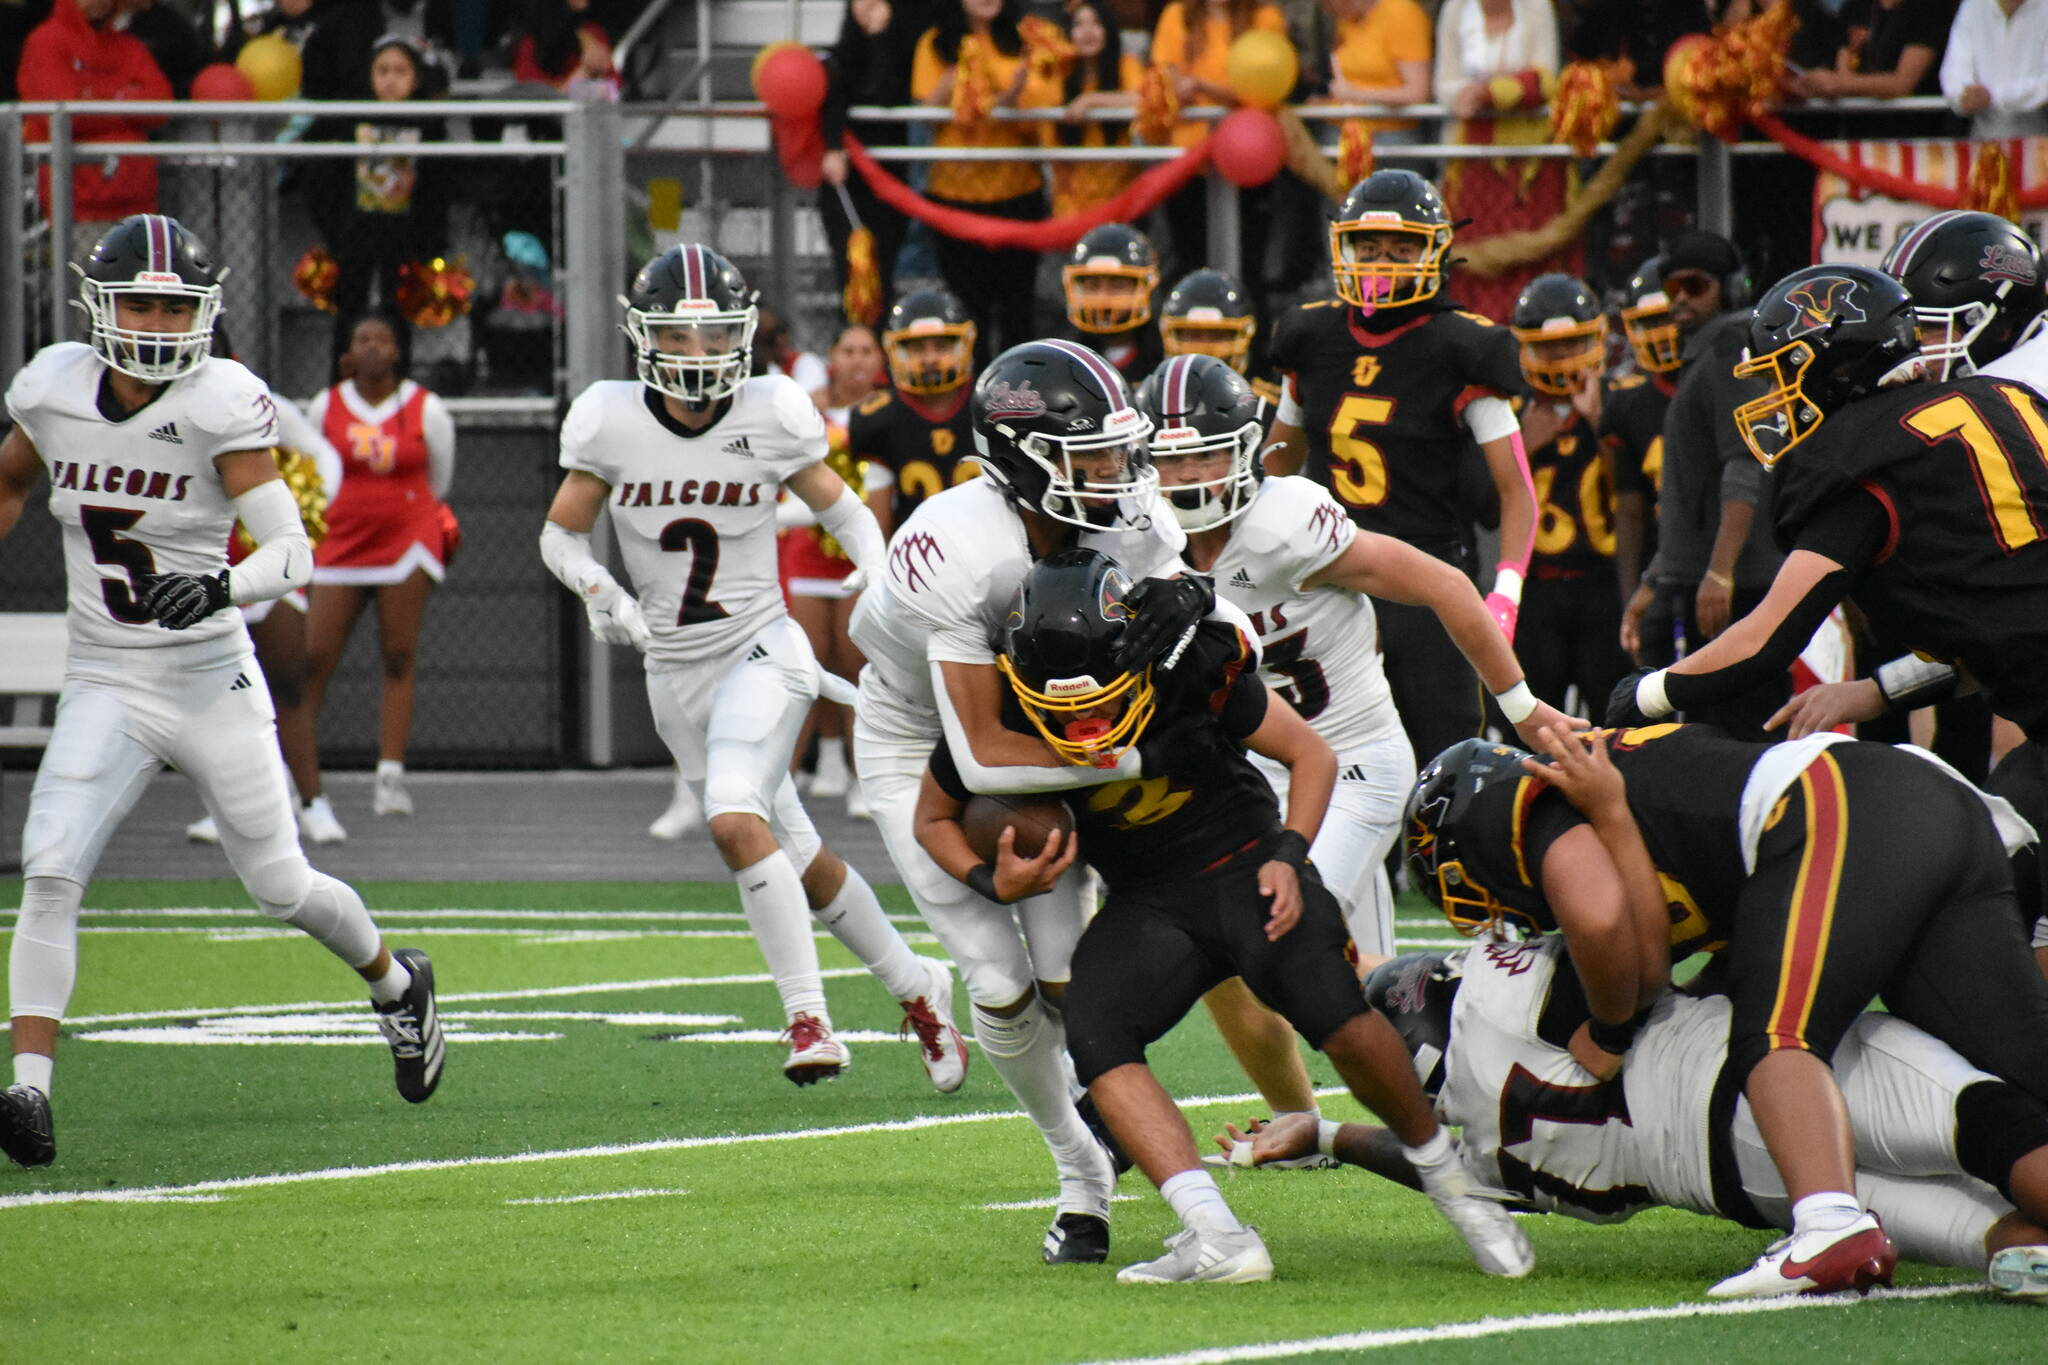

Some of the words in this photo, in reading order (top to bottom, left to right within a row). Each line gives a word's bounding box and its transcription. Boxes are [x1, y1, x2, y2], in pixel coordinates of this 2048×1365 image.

[1832, 222, 1881, 250] WE
[1328, 391, 1398, 509] 5
[52, 460, 194, 501] FALCONS
[617, 480, 761, 507] FALCONS
[80, 504, 158, 625] 5
[659, 517, 732, 627] 2
[1051, 680, 1090, 692] Riddell
